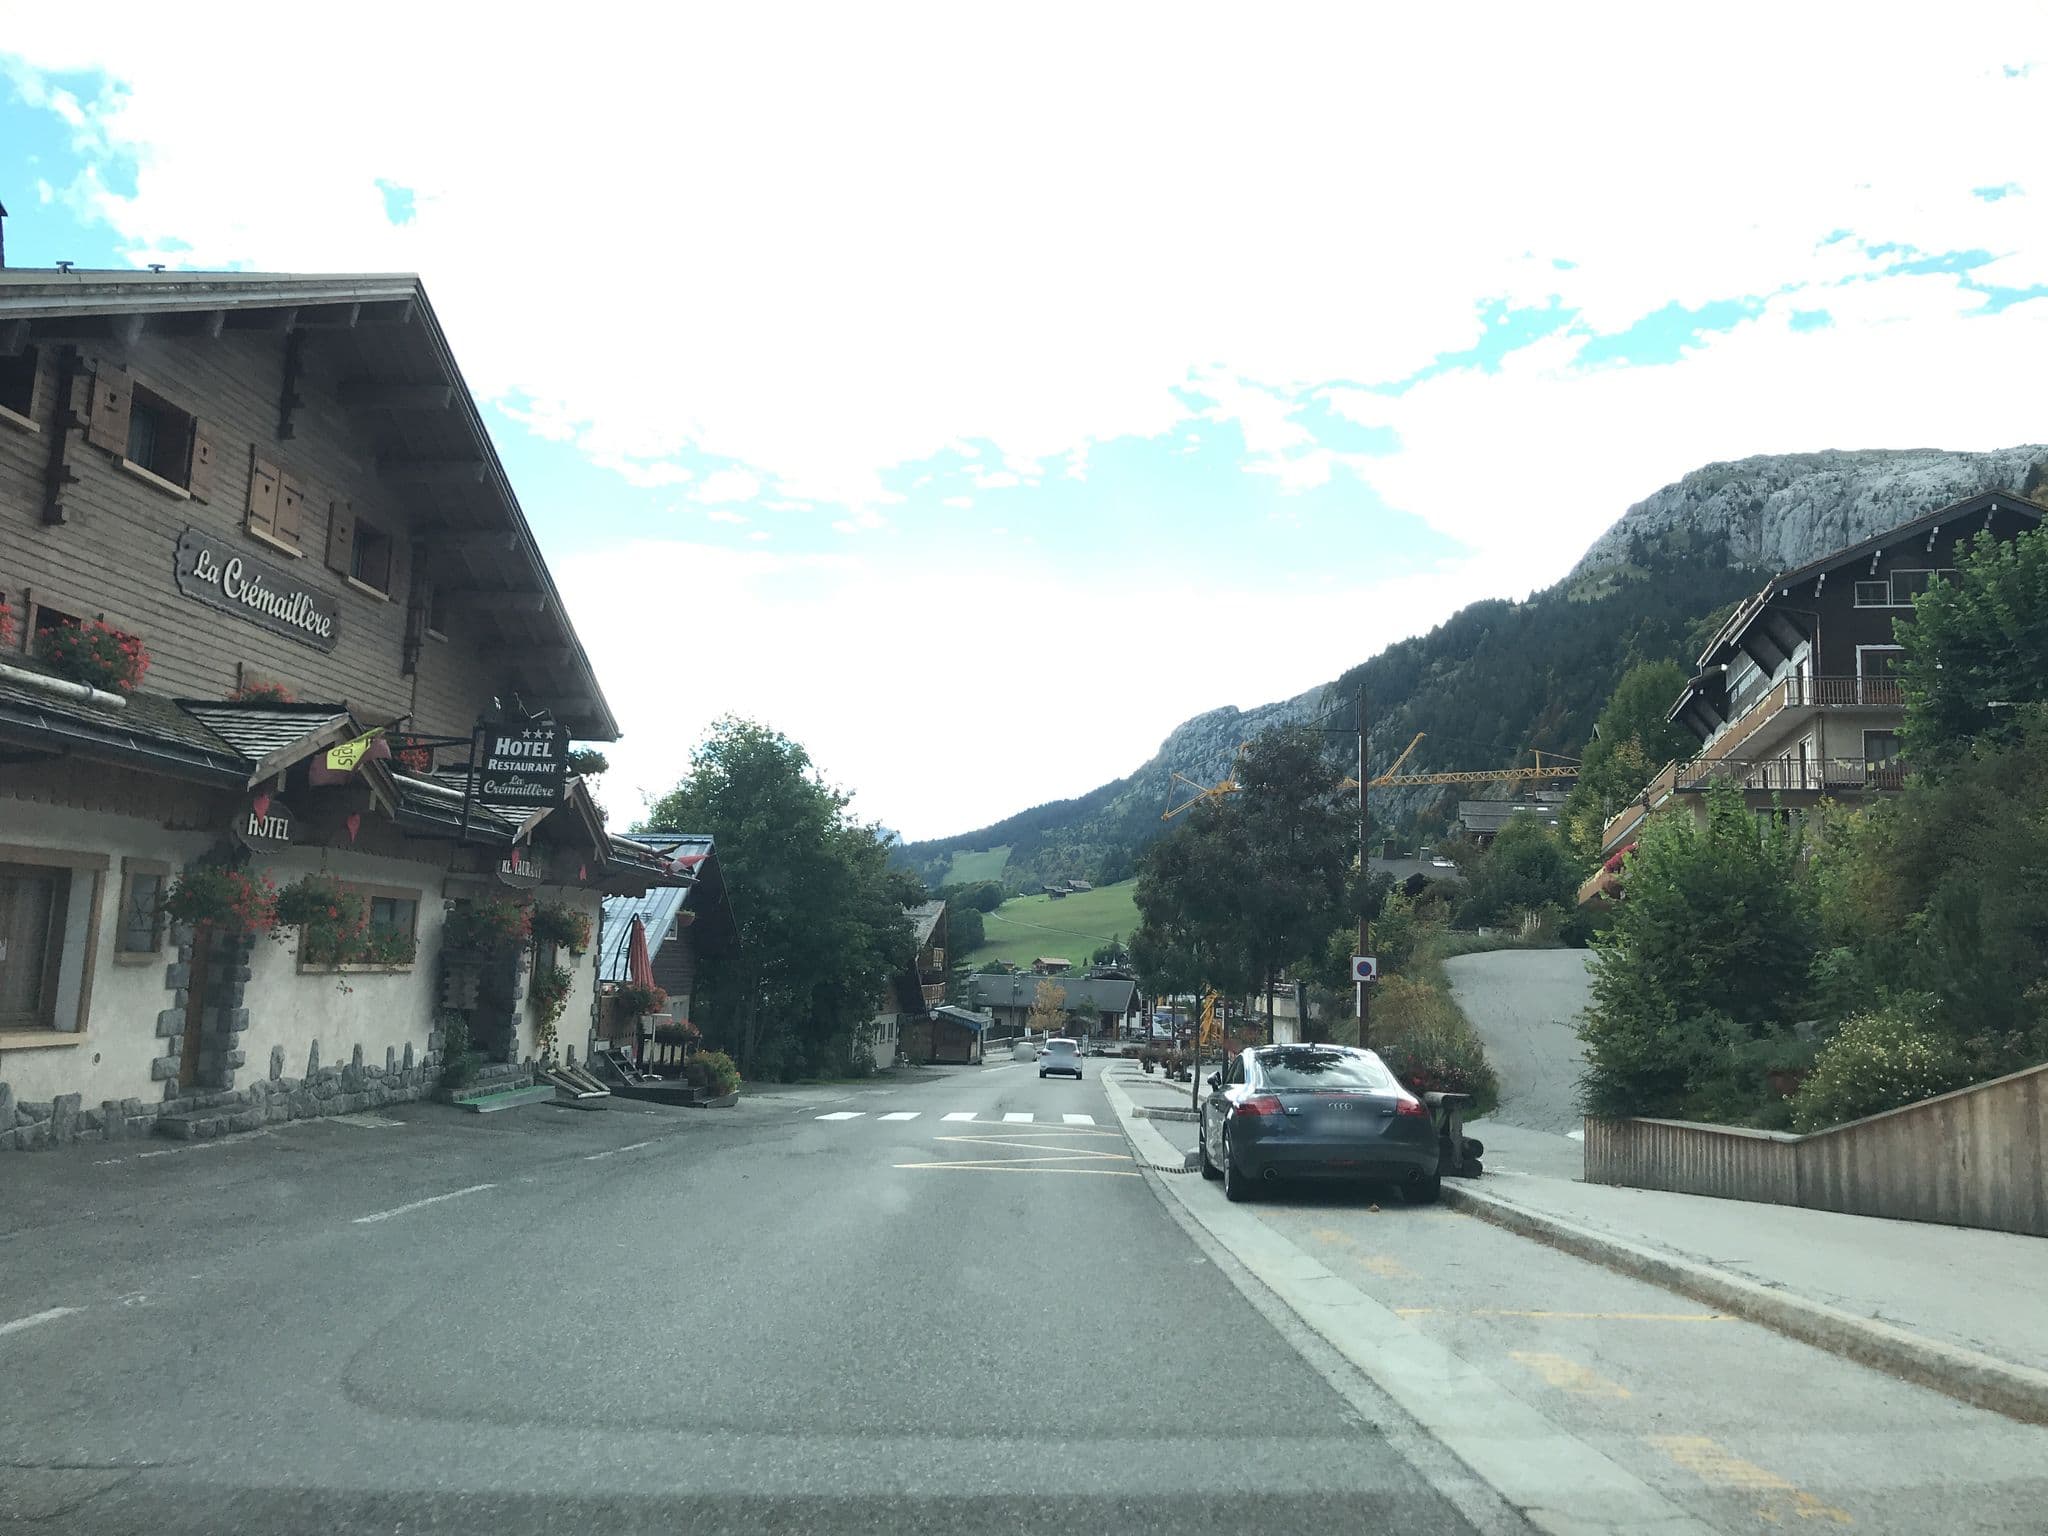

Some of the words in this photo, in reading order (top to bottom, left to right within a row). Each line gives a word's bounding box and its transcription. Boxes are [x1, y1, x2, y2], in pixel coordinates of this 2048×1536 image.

[193, 550, 219, 584] La
[224, 558, 331, 637] Crémaillère
[494, 738, 553, 757] HOTEL
[488, 759, 556, 773] RESTAURANT
[483, 780, 554, 797] Crémaillère
[509, 775, 525, 785] La
[248, 813, 289, 840] HOTEL
